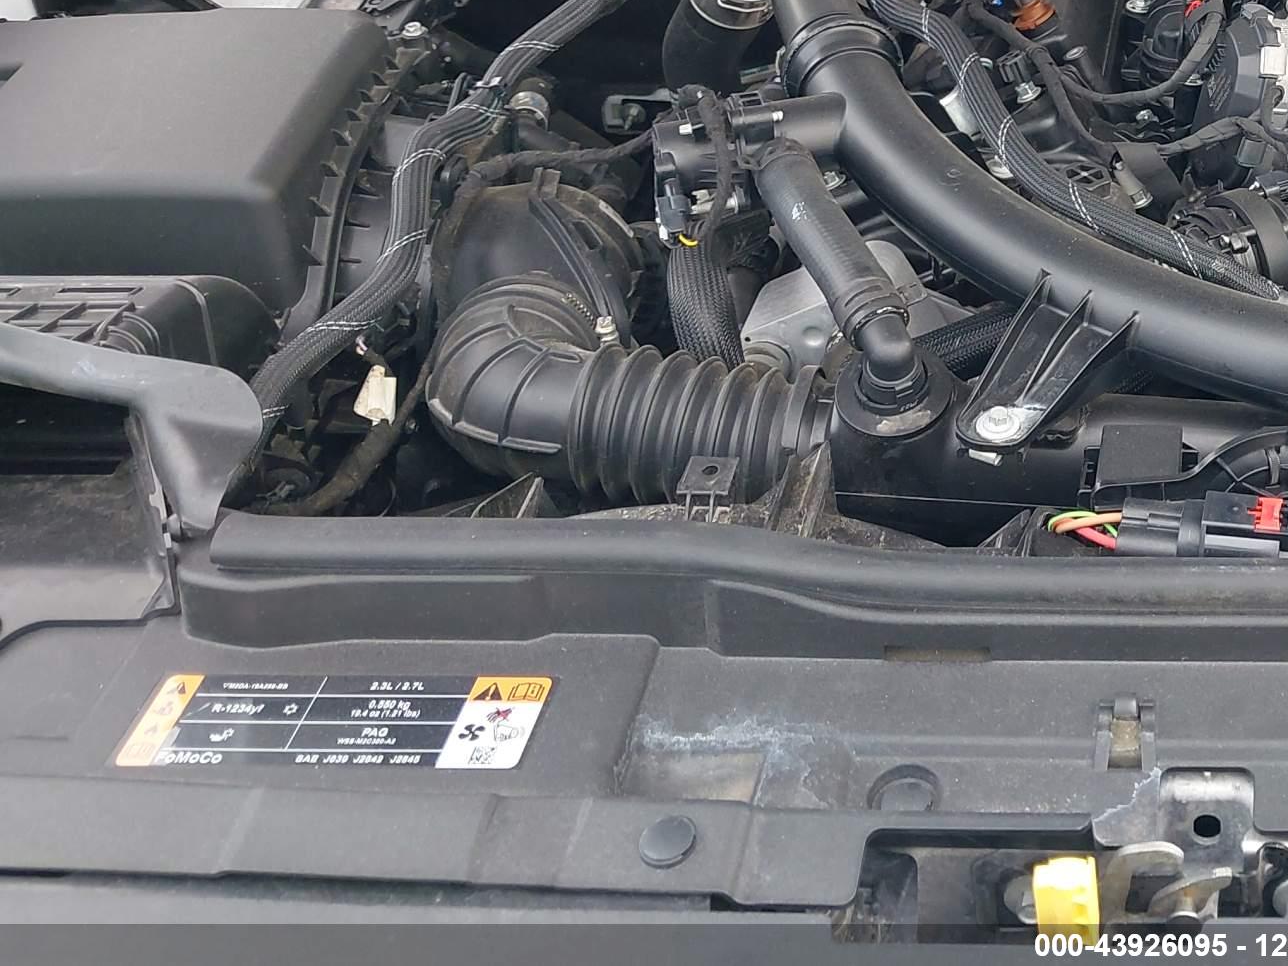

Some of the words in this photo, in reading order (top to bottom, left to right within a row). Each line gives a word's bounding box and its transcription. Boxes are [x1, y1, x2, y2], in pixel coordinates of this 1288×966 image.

[370, 681, 394, 691] 2.3L
[394, 681, 402, 691] /
[402, 681, 425, 691] 2.7L
[211, 703, 265, 715] R-1234yf
[397, 699, 411, 711] kg
[155, 752, 223, 764] FoMoCo
